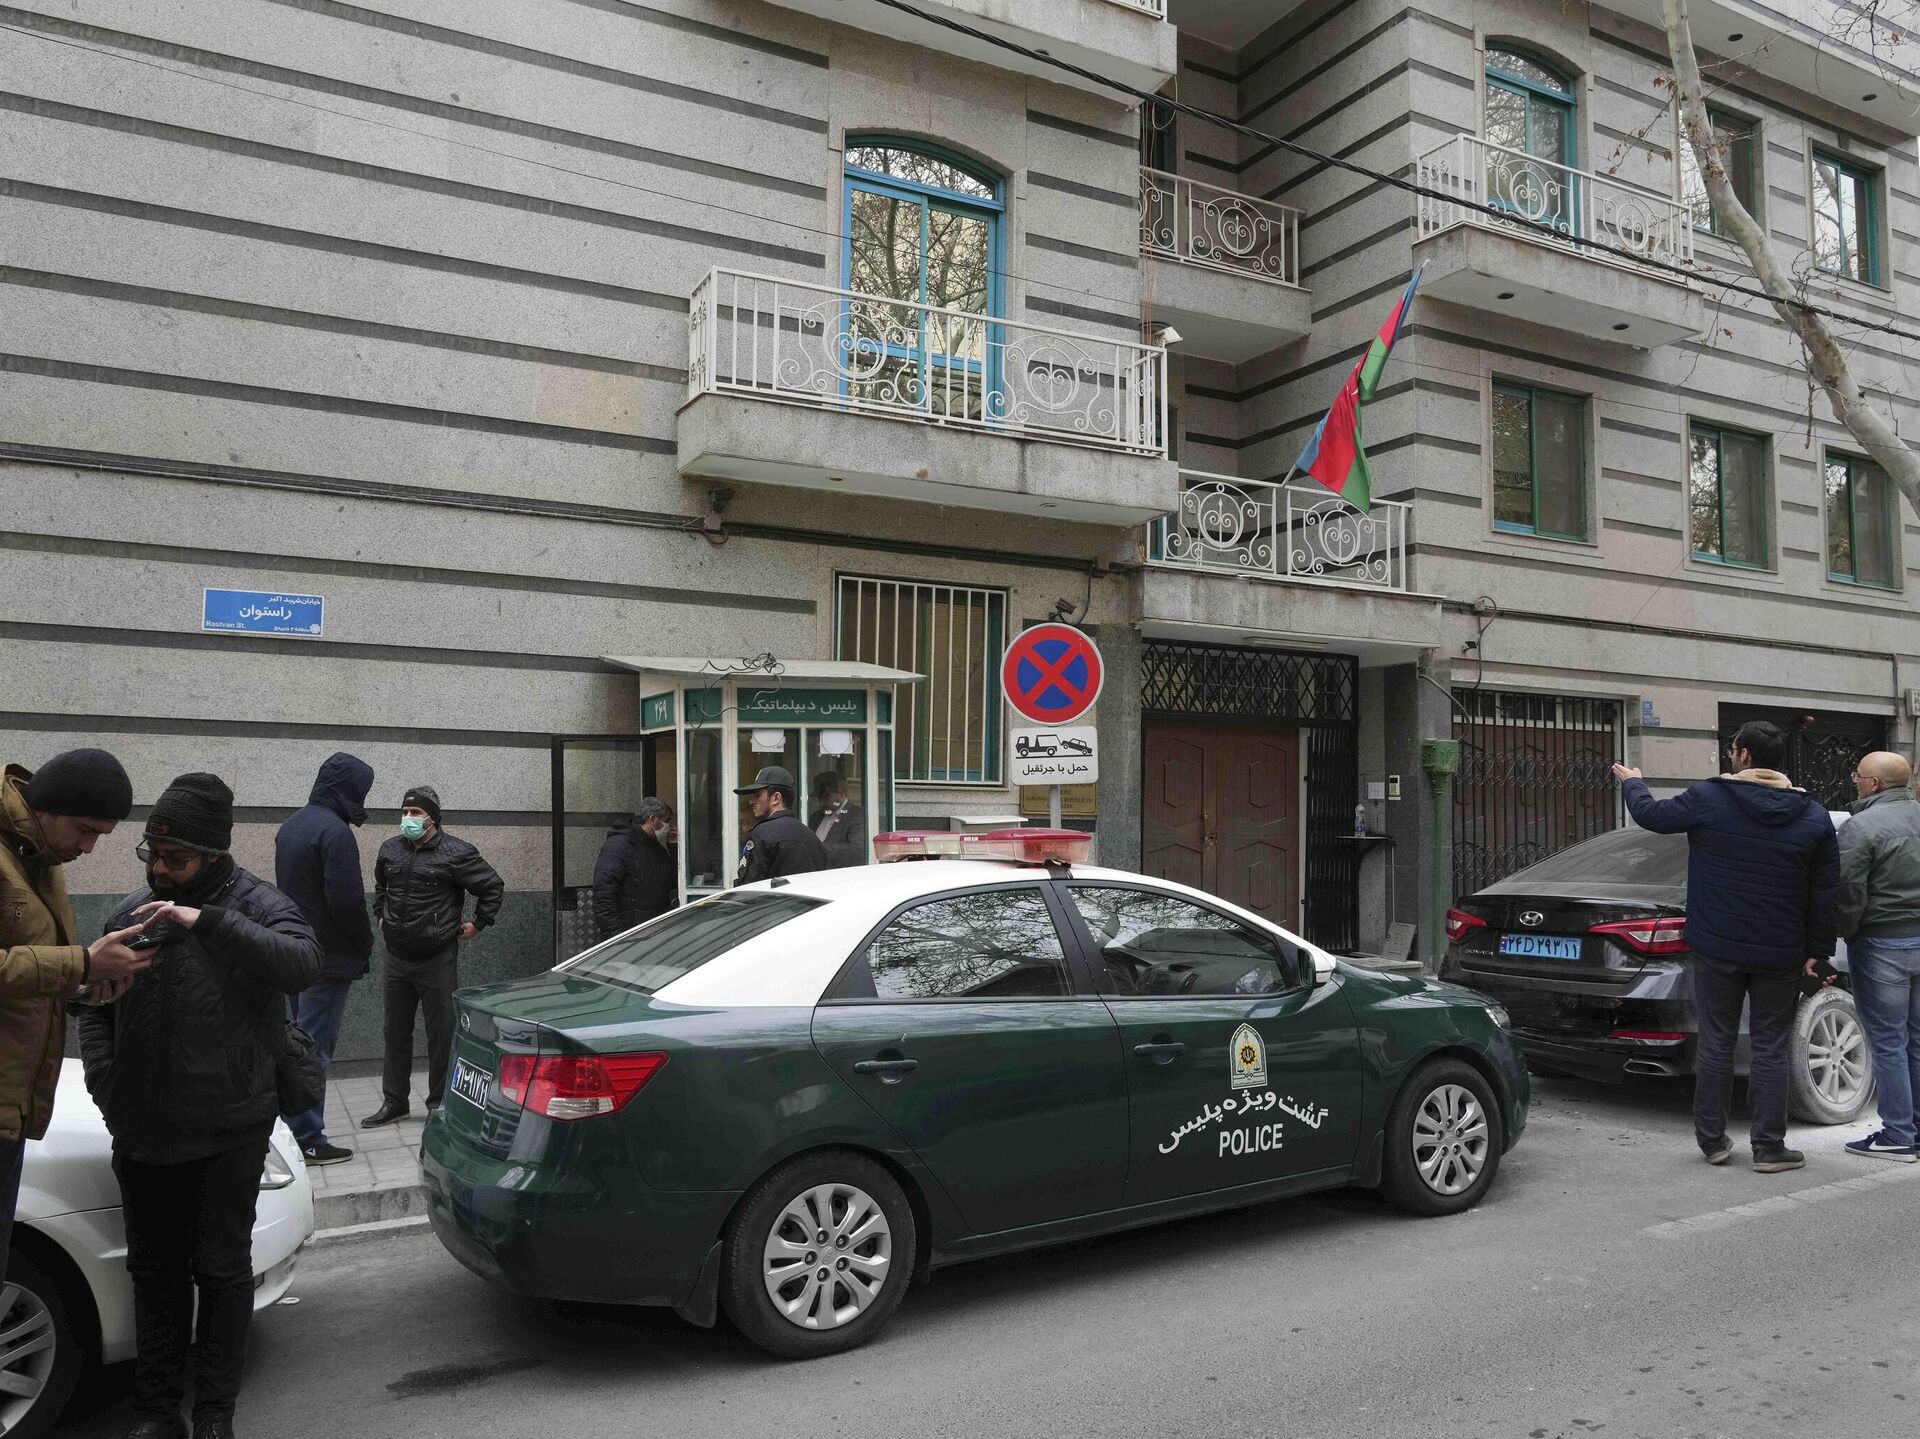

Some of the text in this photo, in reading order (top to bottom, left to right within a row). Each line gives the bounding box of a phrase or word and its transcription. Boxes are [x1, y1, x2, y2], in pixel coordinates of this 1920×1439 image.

[268, 595, 283, 603] اکبر
[283, 597, 302, 605] شهید
[239, 604, 292, 620] راستوان
[205, 620, 235, 628] Rastvan
[746, 699, 816, 715] دیپلماتیک
[1022, 763, 1088, 776] حمل با جرثقیل
[1158, 1089, 1329, 1154] گشت ویژه پلیس
[1219, 1123, 1283, 1158] POLICE
